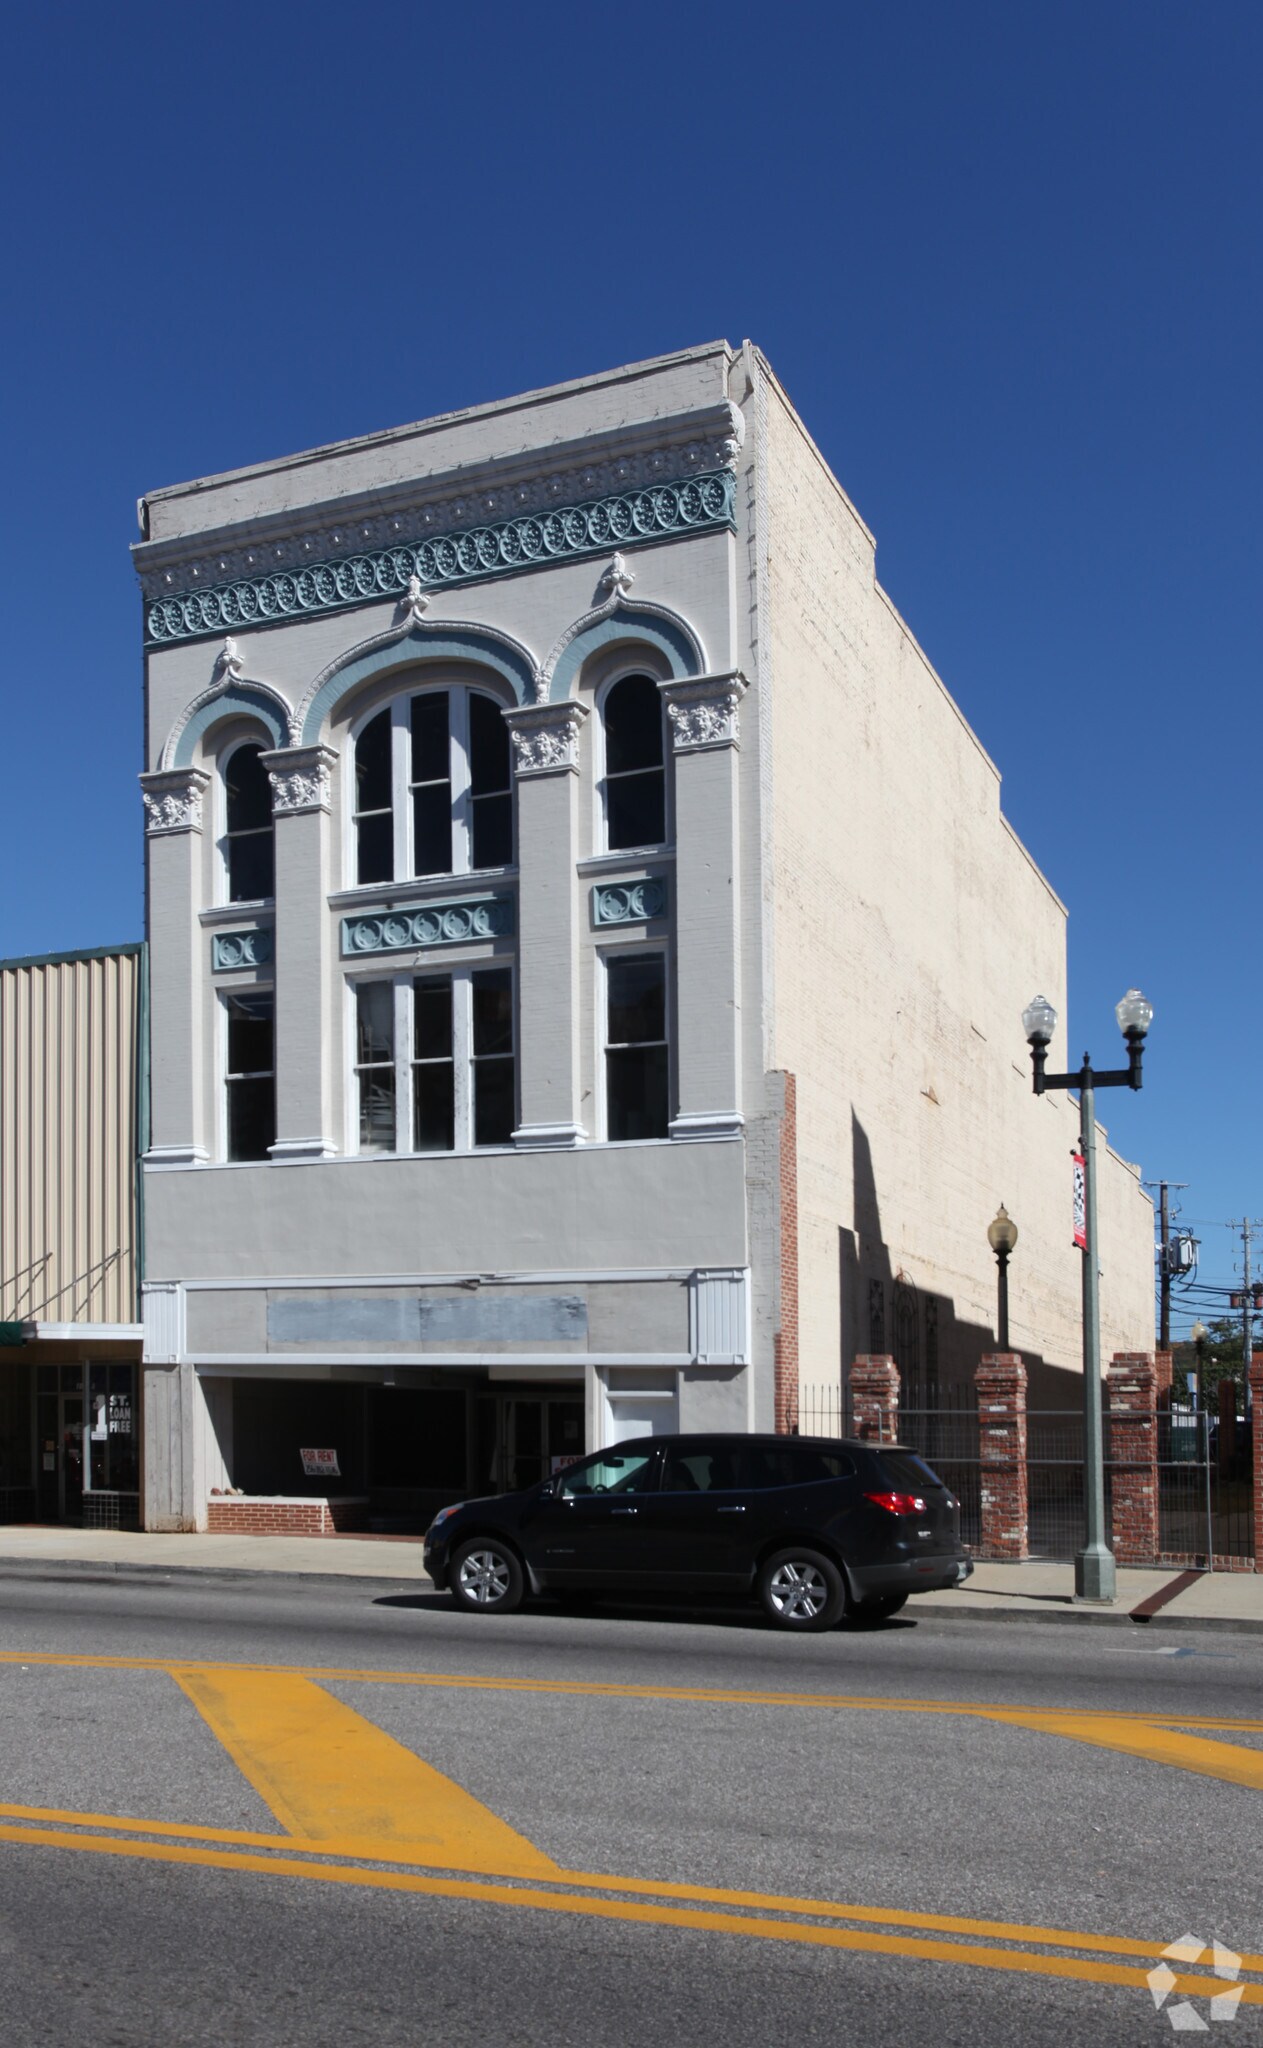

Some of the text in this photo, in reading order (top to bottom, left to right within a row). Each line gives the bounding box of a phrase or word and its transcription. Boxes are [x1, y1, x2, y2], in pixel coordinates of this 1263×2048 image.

[109, 1407, 131, 1419] LOAN
[109, 1421, 131, 1433] FREE
[302, 1450, 334, 1462] FOR RENT
